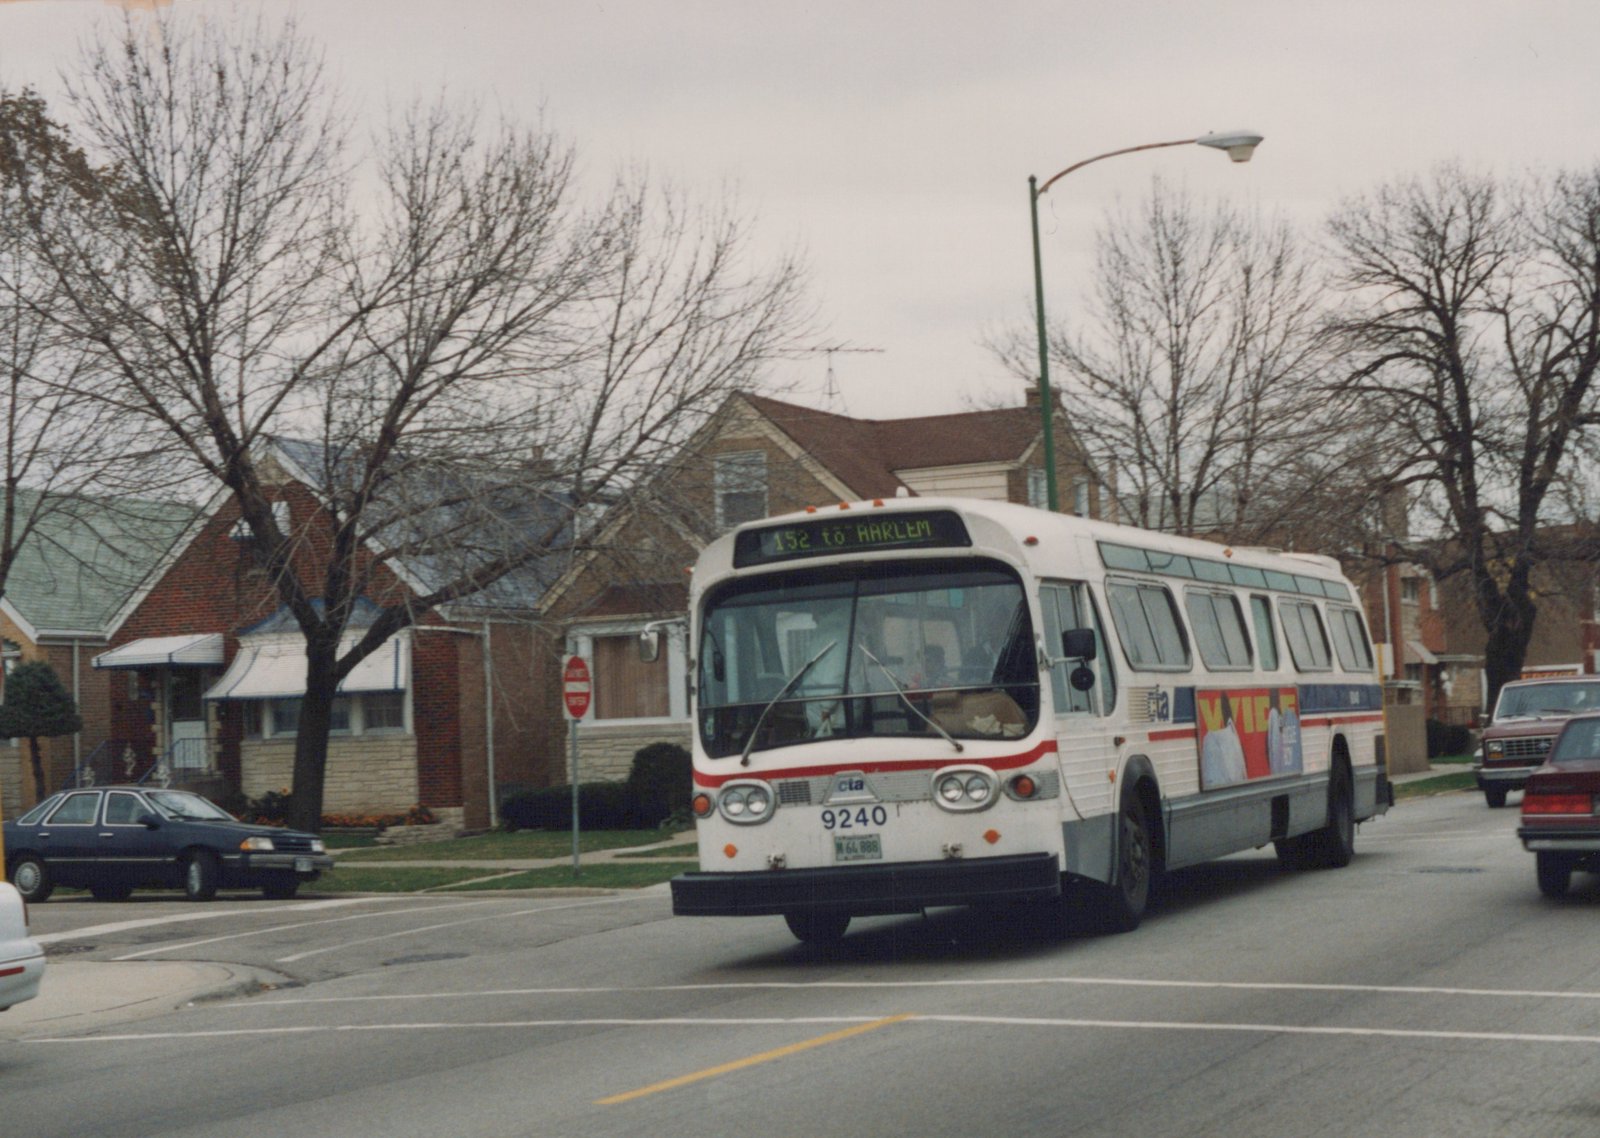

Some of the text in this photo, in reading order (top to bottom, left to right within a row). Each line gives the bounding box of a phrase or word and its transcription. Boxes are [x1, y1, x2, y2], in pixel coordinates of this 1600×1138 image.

[773, 530, 810, 551] 152
[838, 779, 864, 792] cta
[822, 806, 887, 830] 9240
